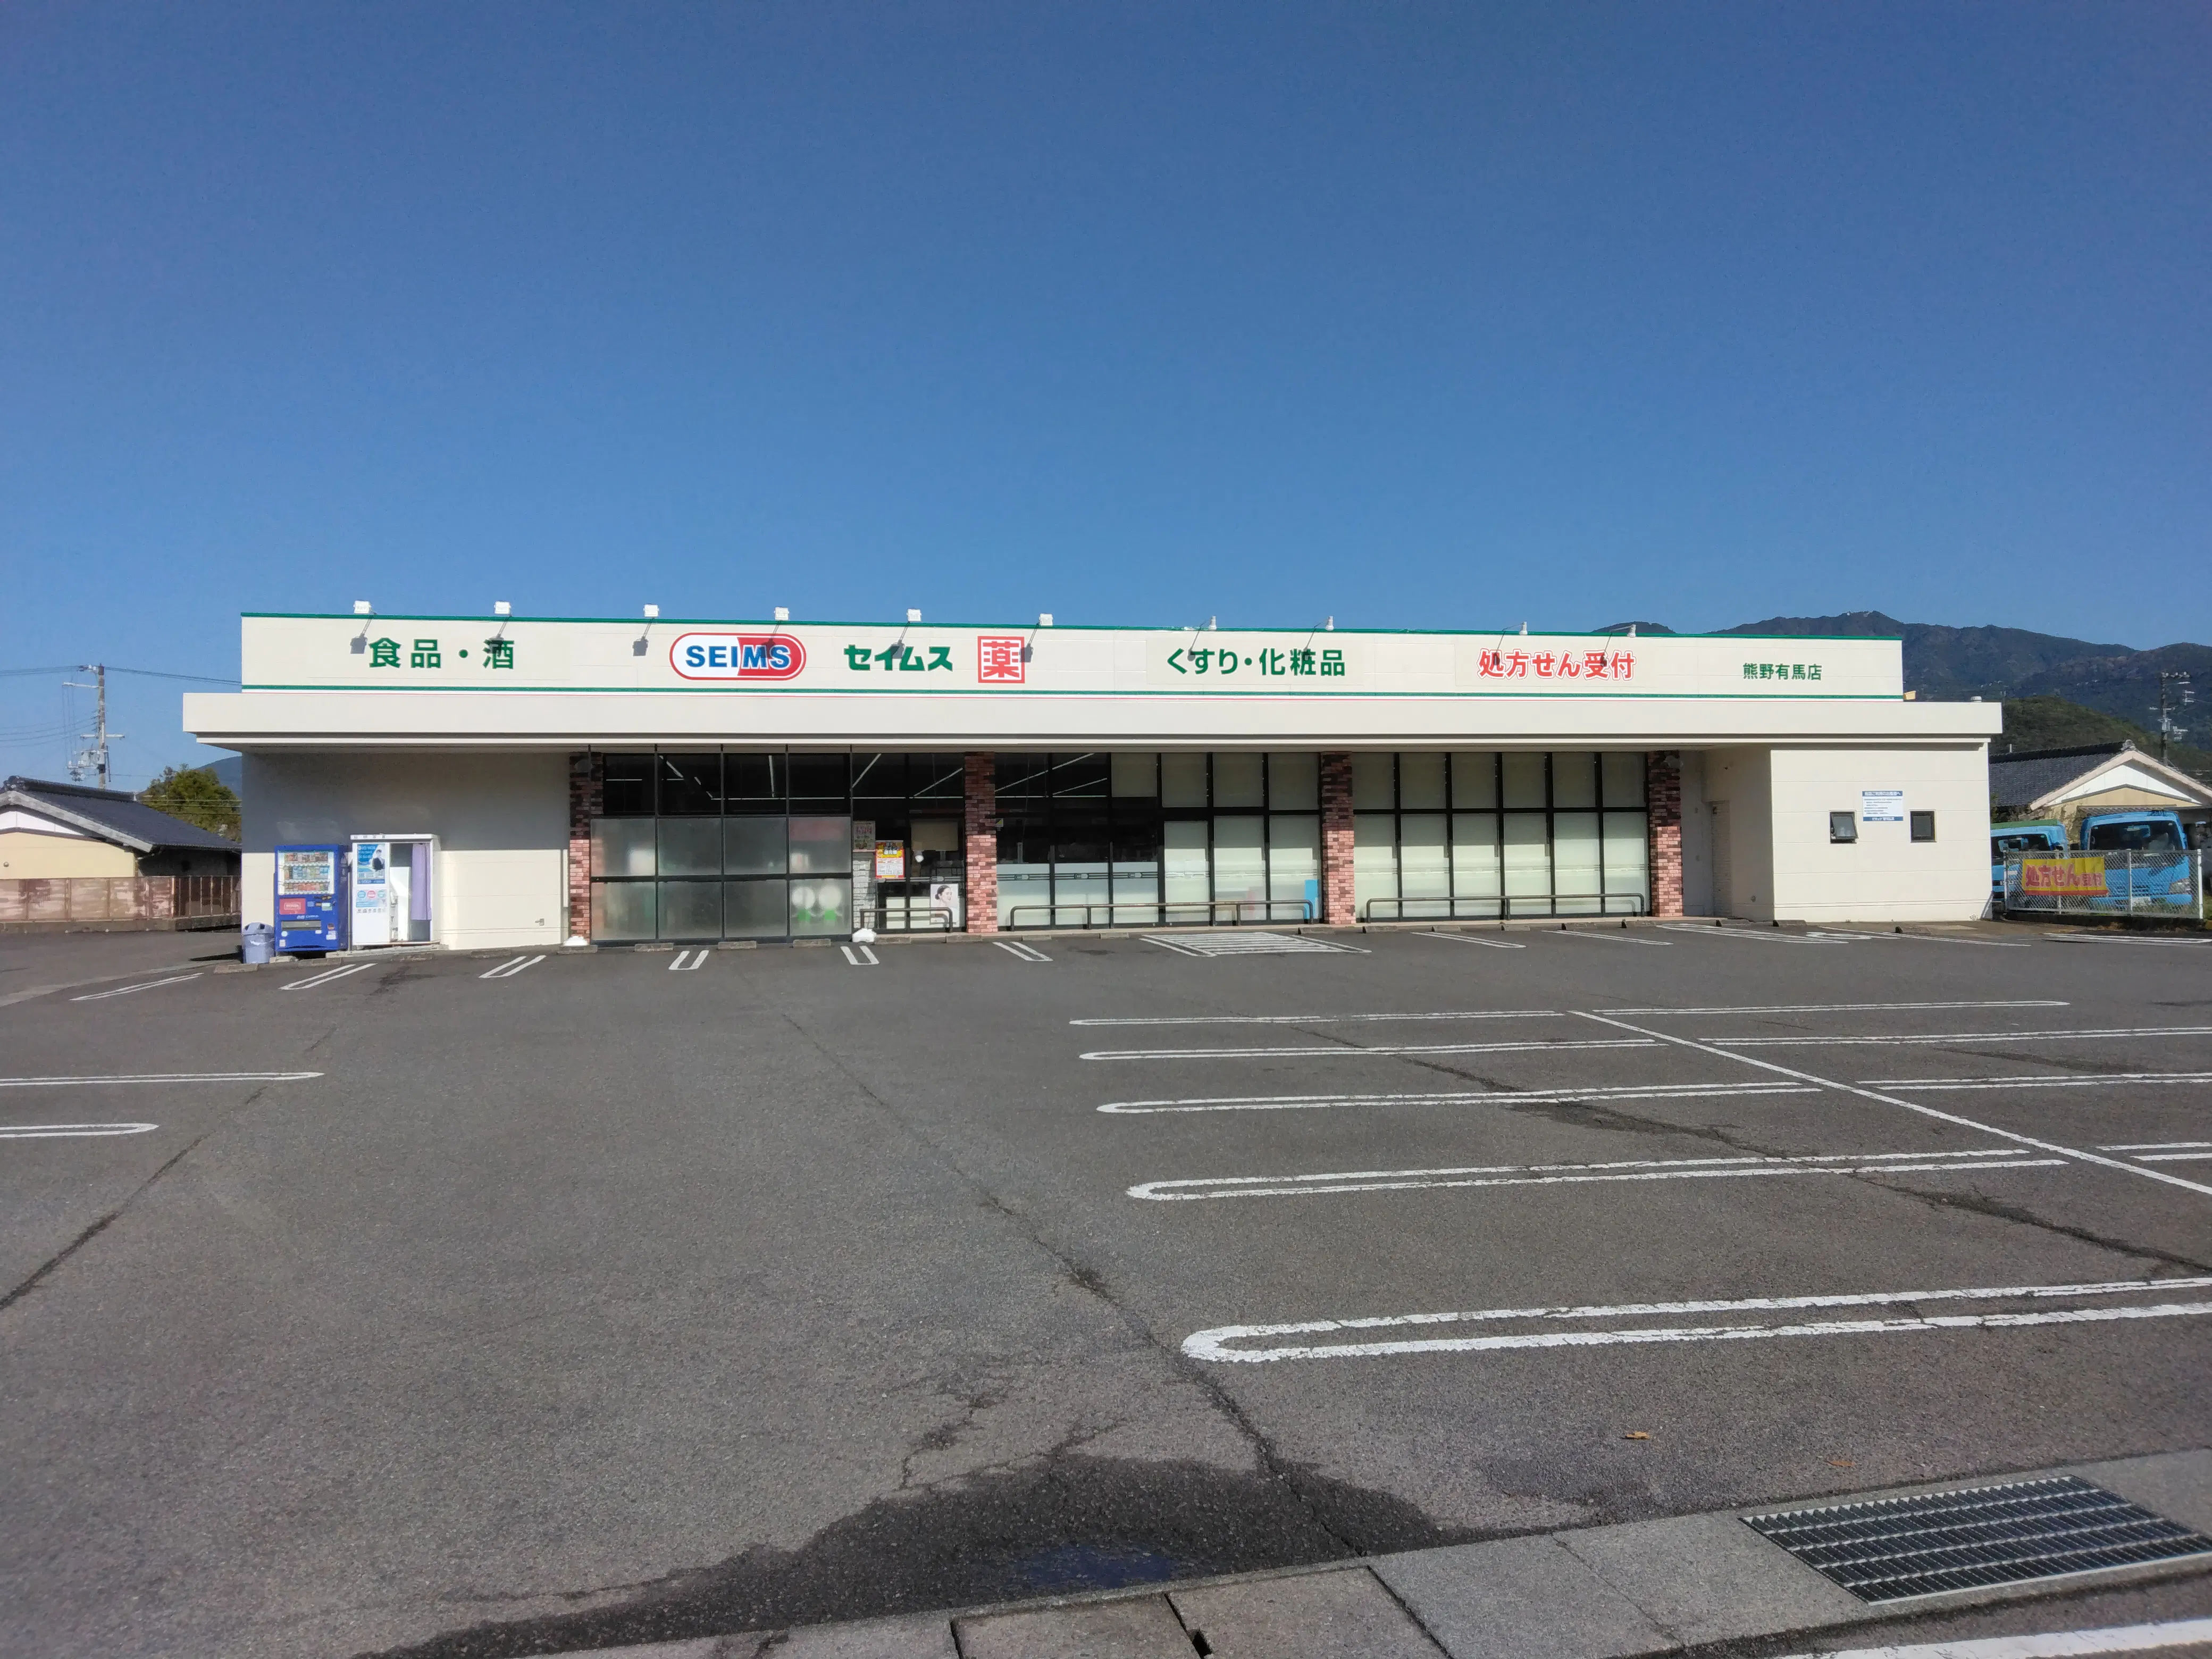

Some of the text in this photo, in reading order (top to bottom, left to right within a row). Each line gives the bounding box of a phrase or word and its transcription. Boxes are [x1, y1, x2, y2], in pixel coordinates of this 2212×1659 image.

[369, 638, 514, 669] 食品・酒
[685, 645, 791, 670] SEIMS
[844, 644, 953, 672] セイムス
[983, 641, 1019, 678] 薬
[1167, 648, 1346, 676] くすり・化粧品
[1478, 650, 1636, 680] 処方せん受付
[1742, 663, 1823, 681] 熊野有馬店
